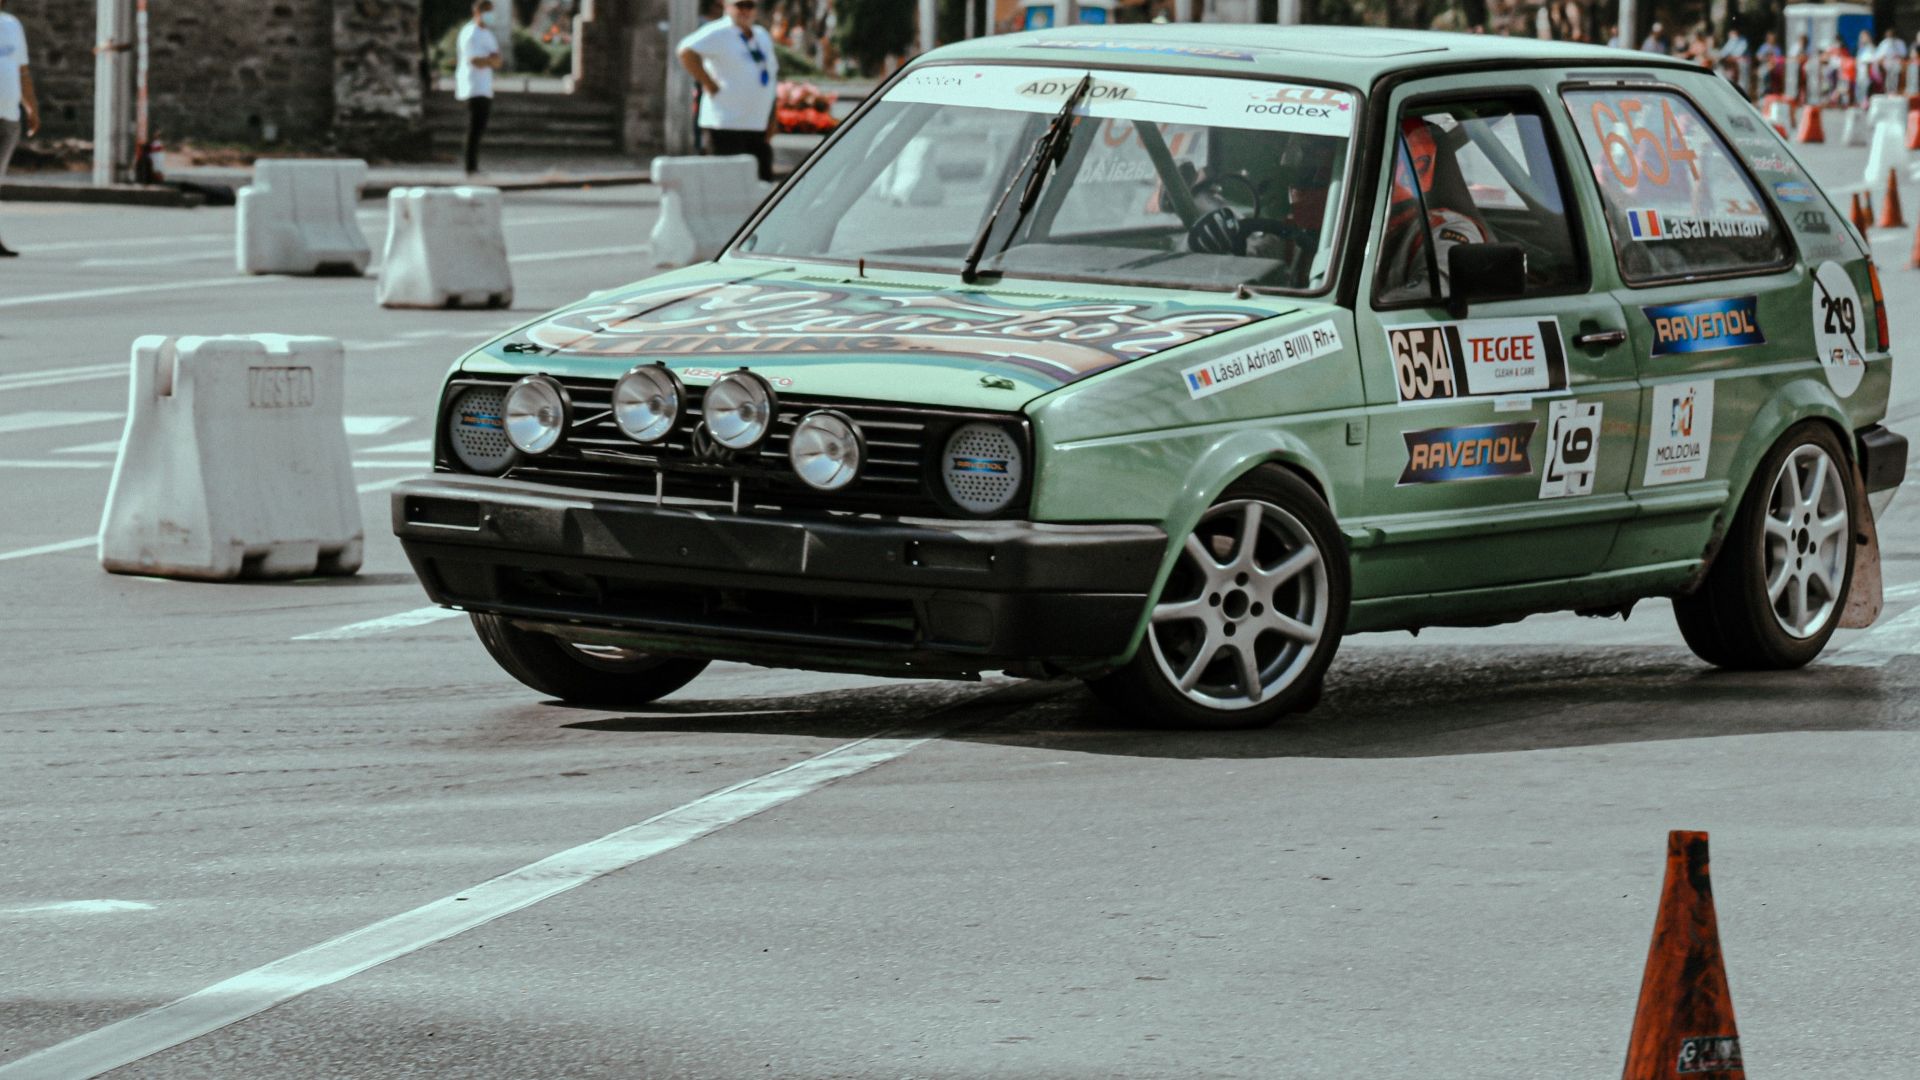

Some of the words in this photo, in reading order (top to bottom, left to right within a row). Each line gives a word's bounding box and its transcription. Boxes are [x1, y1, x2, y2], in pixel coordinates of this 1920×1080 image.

[1021, 82, 1130, 99] ADYOM
[1245, 102, 1332, 118] rodotex
[1592, 96, 1700, 188] 654
[1655, 309, 1756, 344] RAVENOL
[1246, 346, 1284, 372] Adrian
[1313, 328, 1336, 349] Rh+
[1392, 329, 1452, 399] 654
[1468, 335, 1535, 363] TEGEE
[1411, 436, 1524, 471] RAVENOL
[1656, 442, 1700, 462] MOLDOVA
